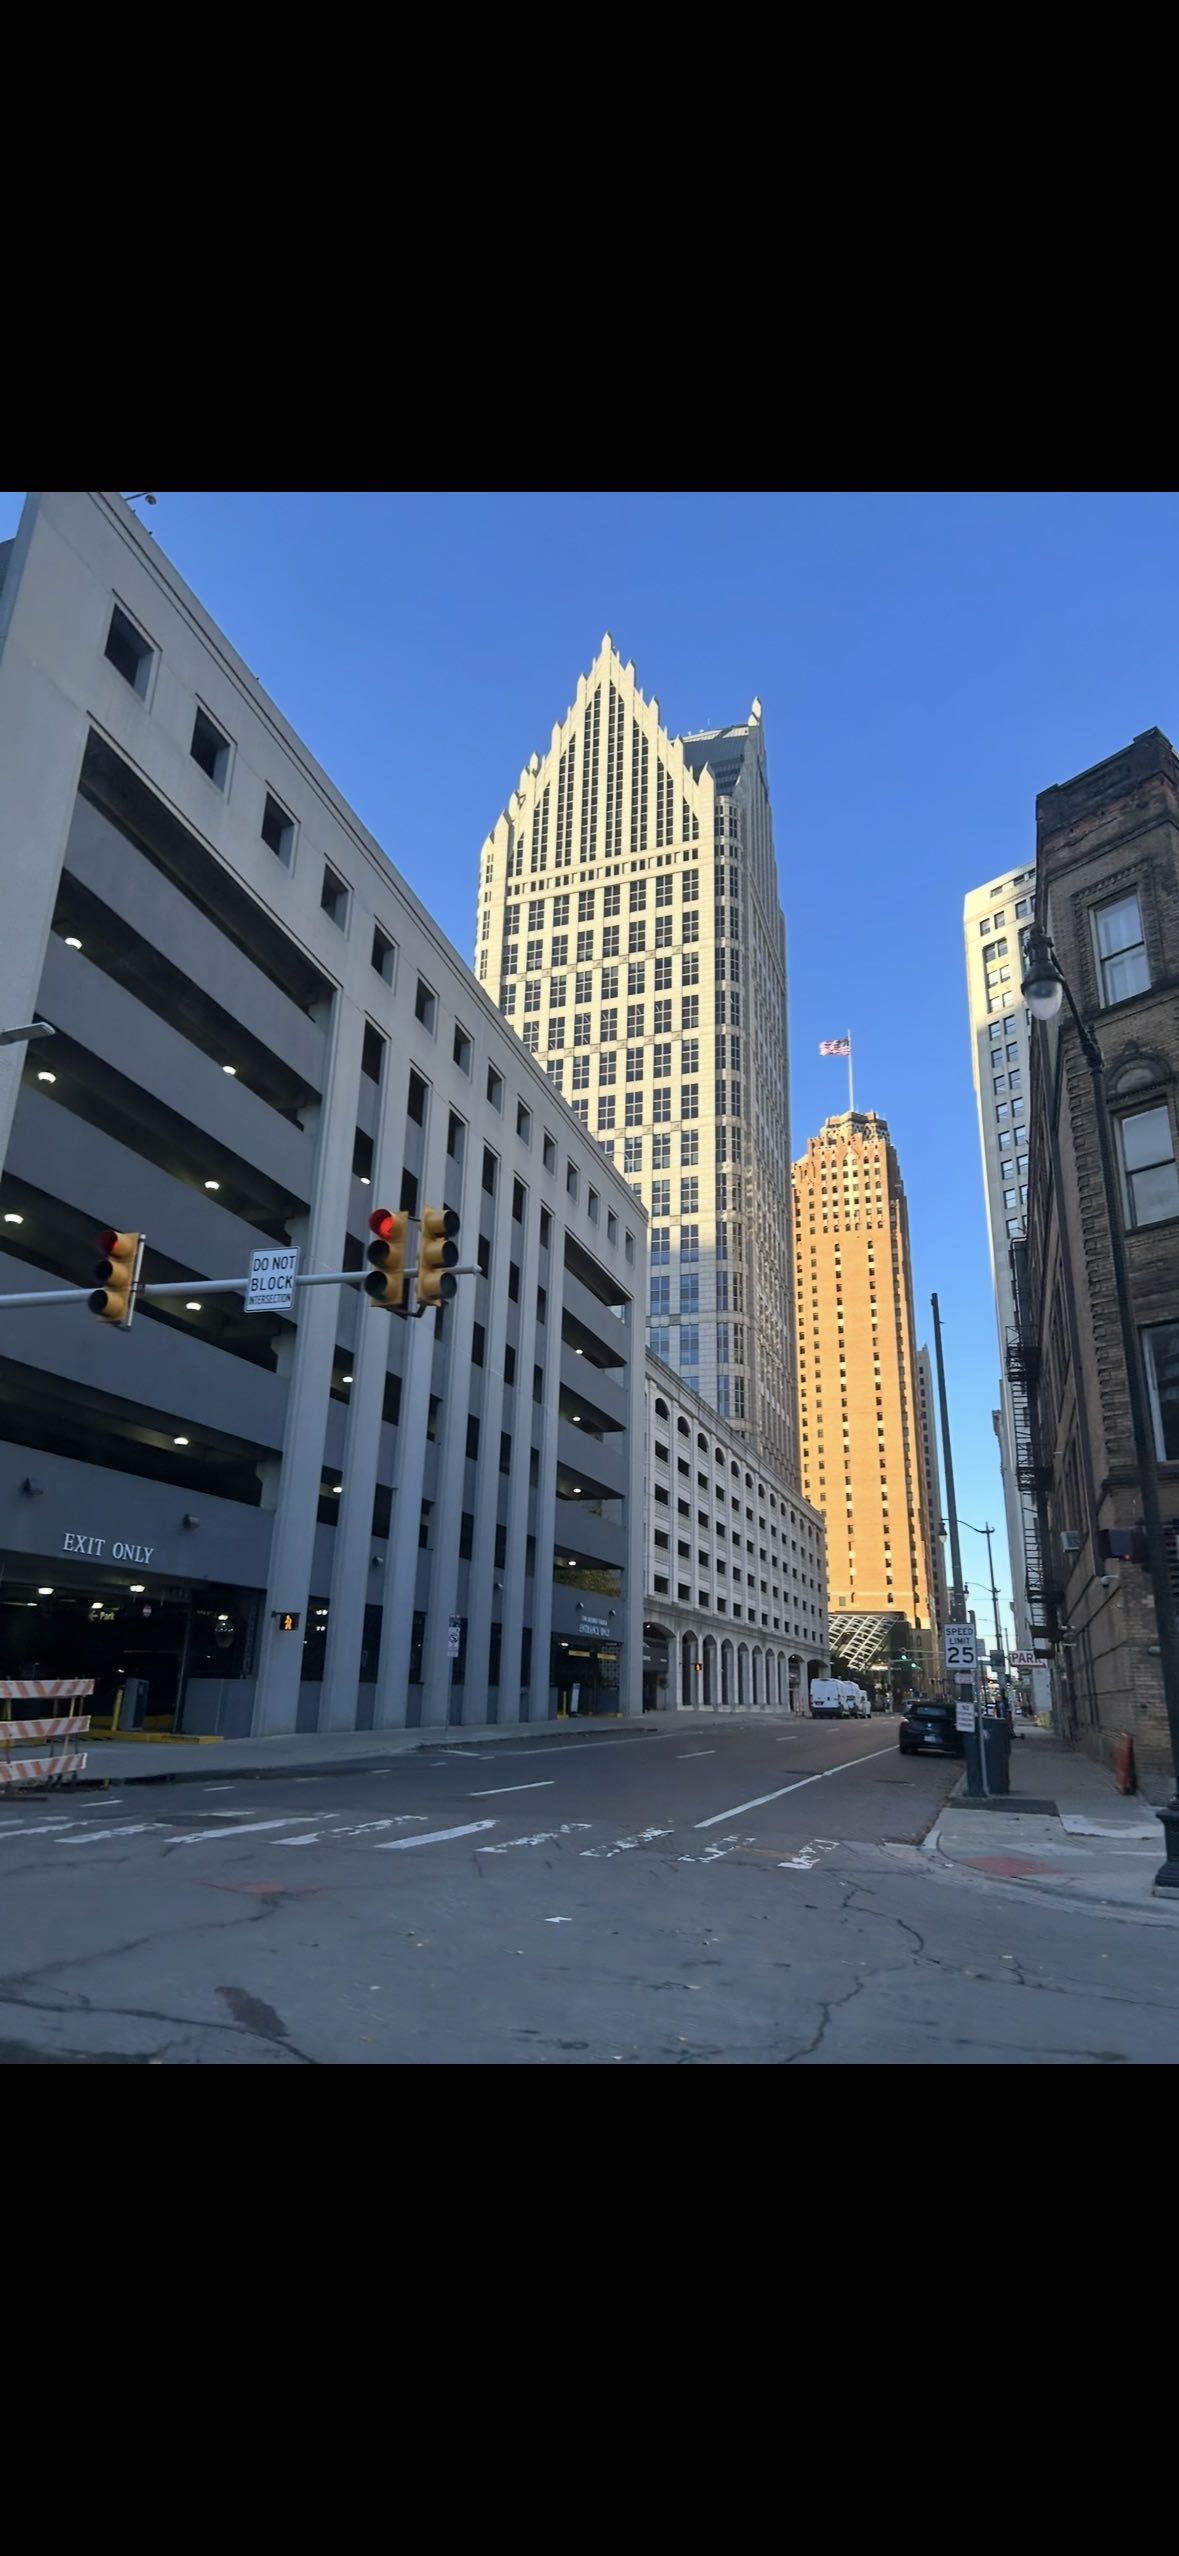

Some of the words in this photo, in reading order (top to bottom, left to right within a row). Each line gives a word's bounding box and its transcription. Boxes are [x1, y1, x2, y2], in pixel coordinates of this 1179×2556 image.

[253, 1257, 269, 1272] DO
[272, 1255, 296, 1270] NOT
[250, 1275, 293, 1292] BLOCK
[248, 1293, 291, 1305] INTERSECTION
[63, 1532, 106, 1556] EXIT
[112, 1542, 154, 1564] ONLY
[945, 1627, 973, 1636] SPEED
[949, 1636, 971, 1645] LIMIT
[947, 1646, 974, 1664] 25
